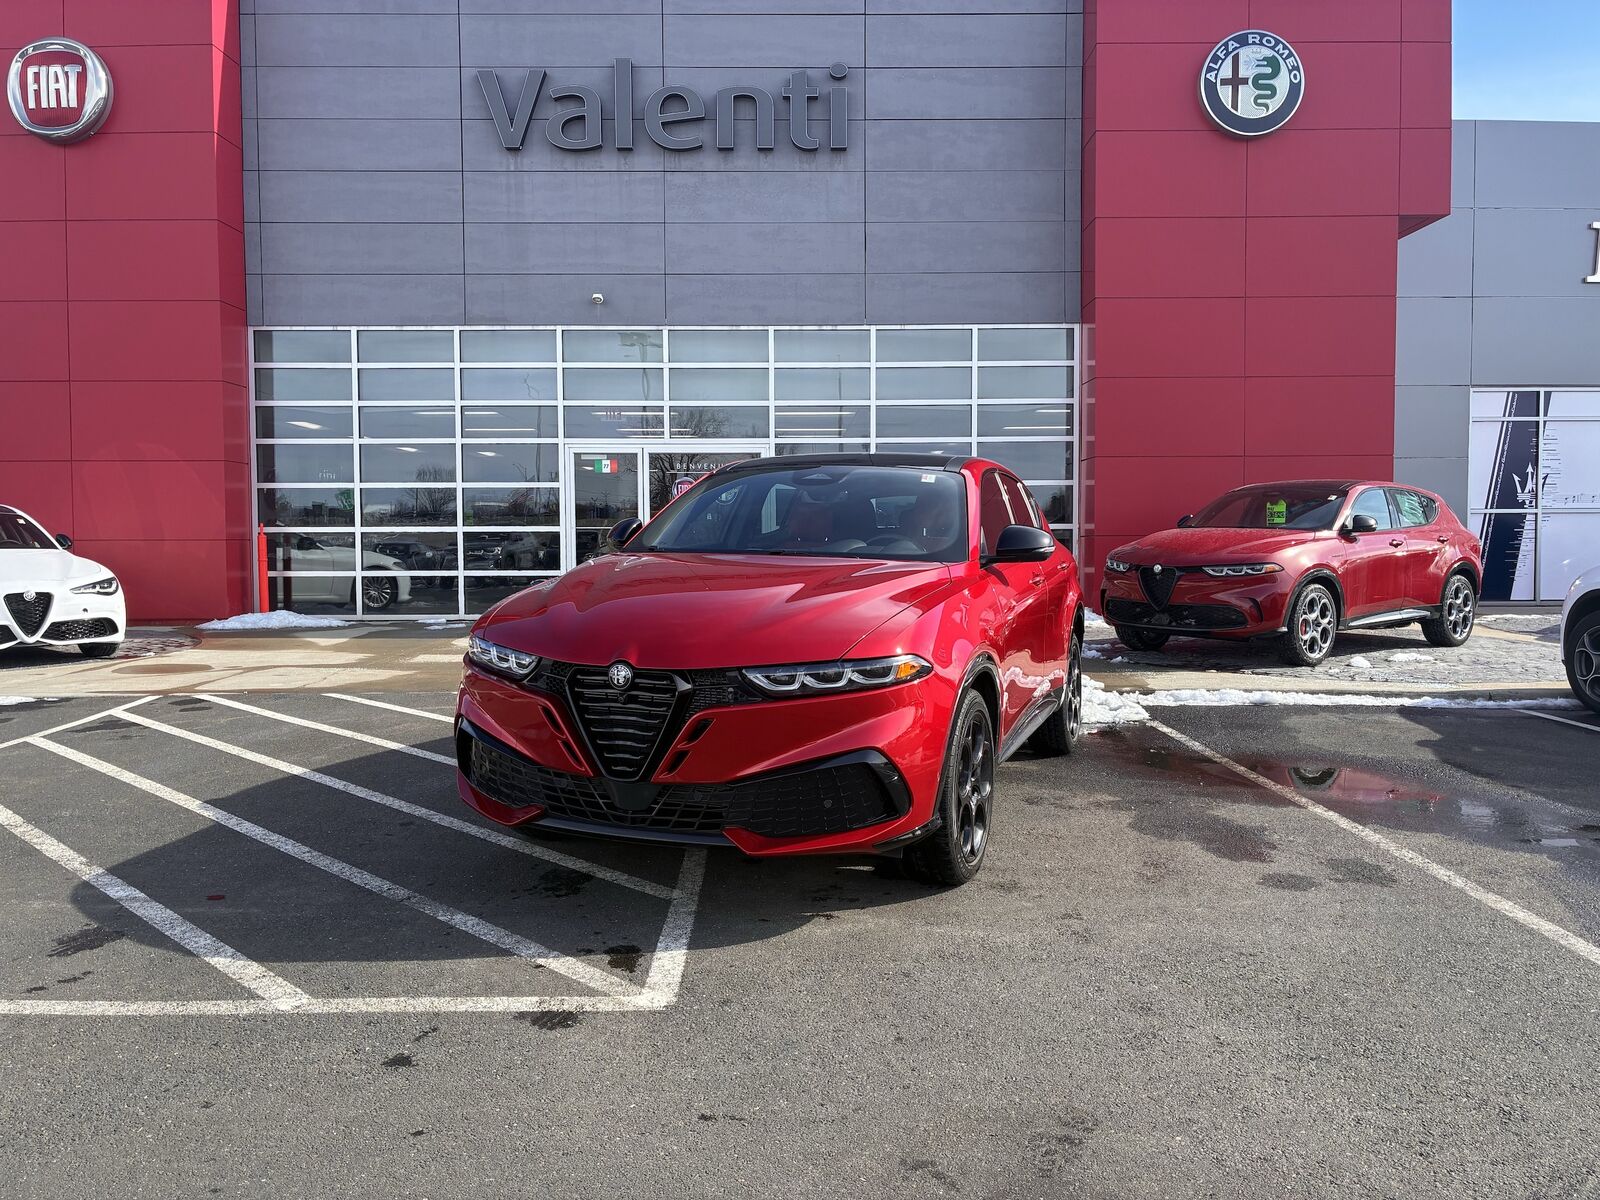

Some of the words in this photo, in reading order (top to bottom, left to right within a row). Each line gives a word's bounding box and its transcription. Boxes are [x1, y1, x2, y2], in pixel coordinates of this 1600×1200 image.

[1205, 40, 1241, 83] ALFA
[1247, 34, 1301, 84] ROMEO
[27, 64, 82, 109] FIAT
[476, 57, 849, 151] Valenti
